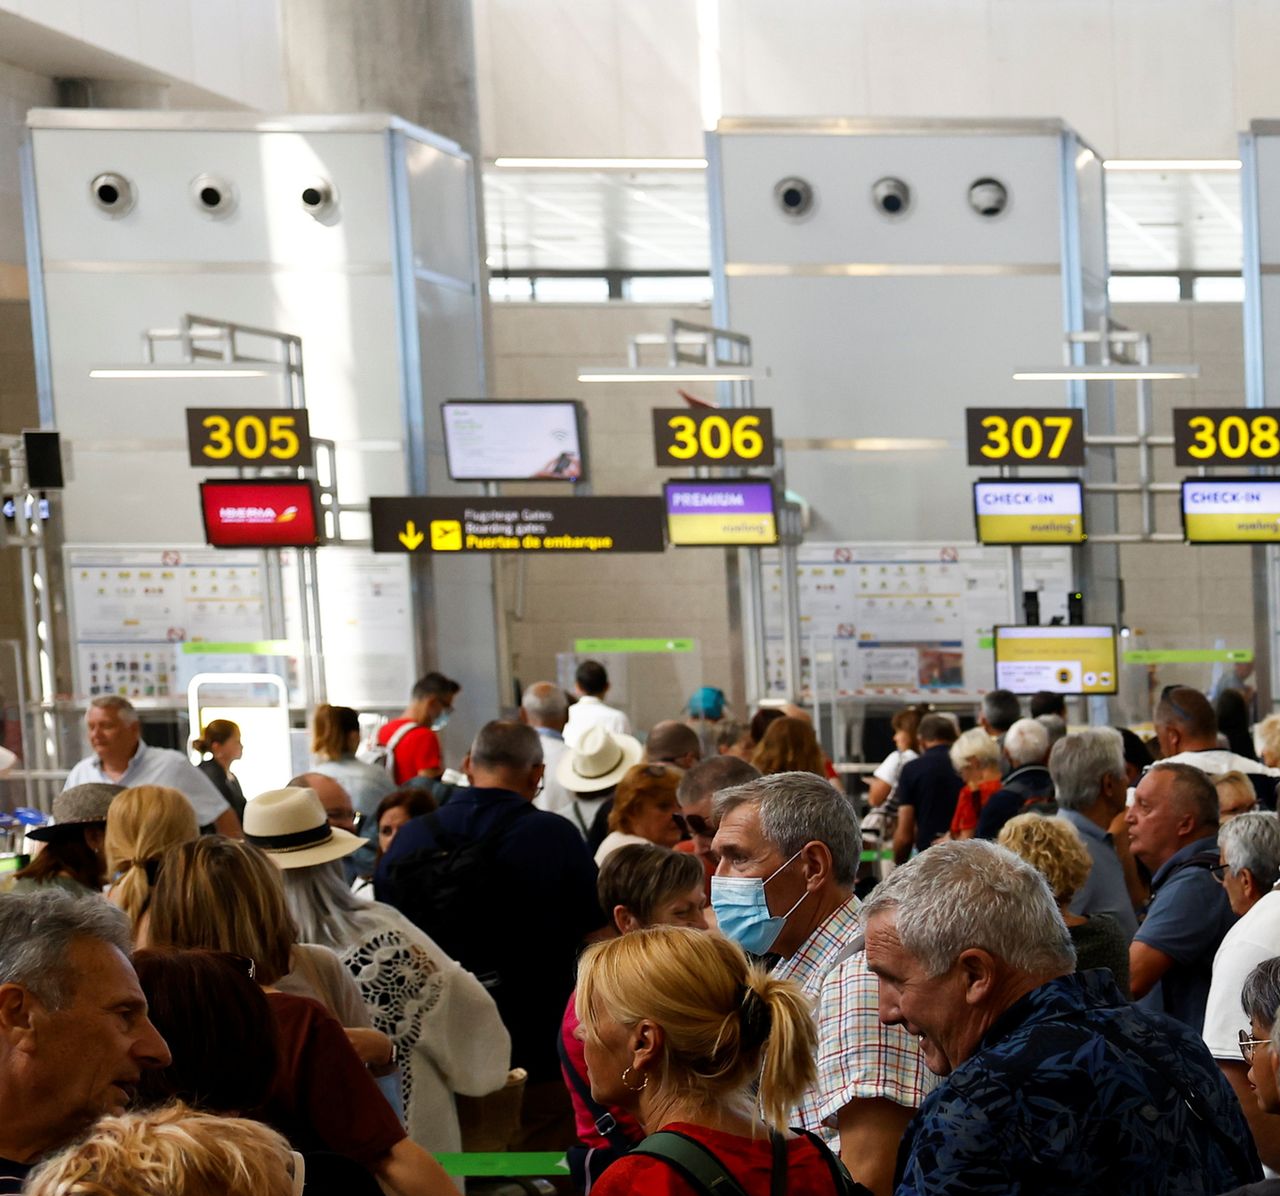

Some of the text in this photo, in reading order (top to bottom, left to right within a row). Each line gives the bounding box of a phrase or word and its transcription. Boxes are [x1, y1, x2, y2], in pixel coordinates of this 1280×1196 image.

[202, 415, 300, 459] 305
[667, 415, 764, 460] 306
[980, 415, 1073, 459] 307
[1188, 415, 1280, 459] 308
[672, 492, 744, 507] PREMIUM
[983, 494, 1053, 504] CHECK-IN
[1191, 492, 1260, 503] CHECK-IN
[219, 507, 277, 518] IBERIA
[465, 522, 547, 536] Boarding gates
[1031, 520, 1073, 535] vueling
[1236, 518, 1280, 533] vueling
[466, 534, 613, 550] Puertas de embarque
